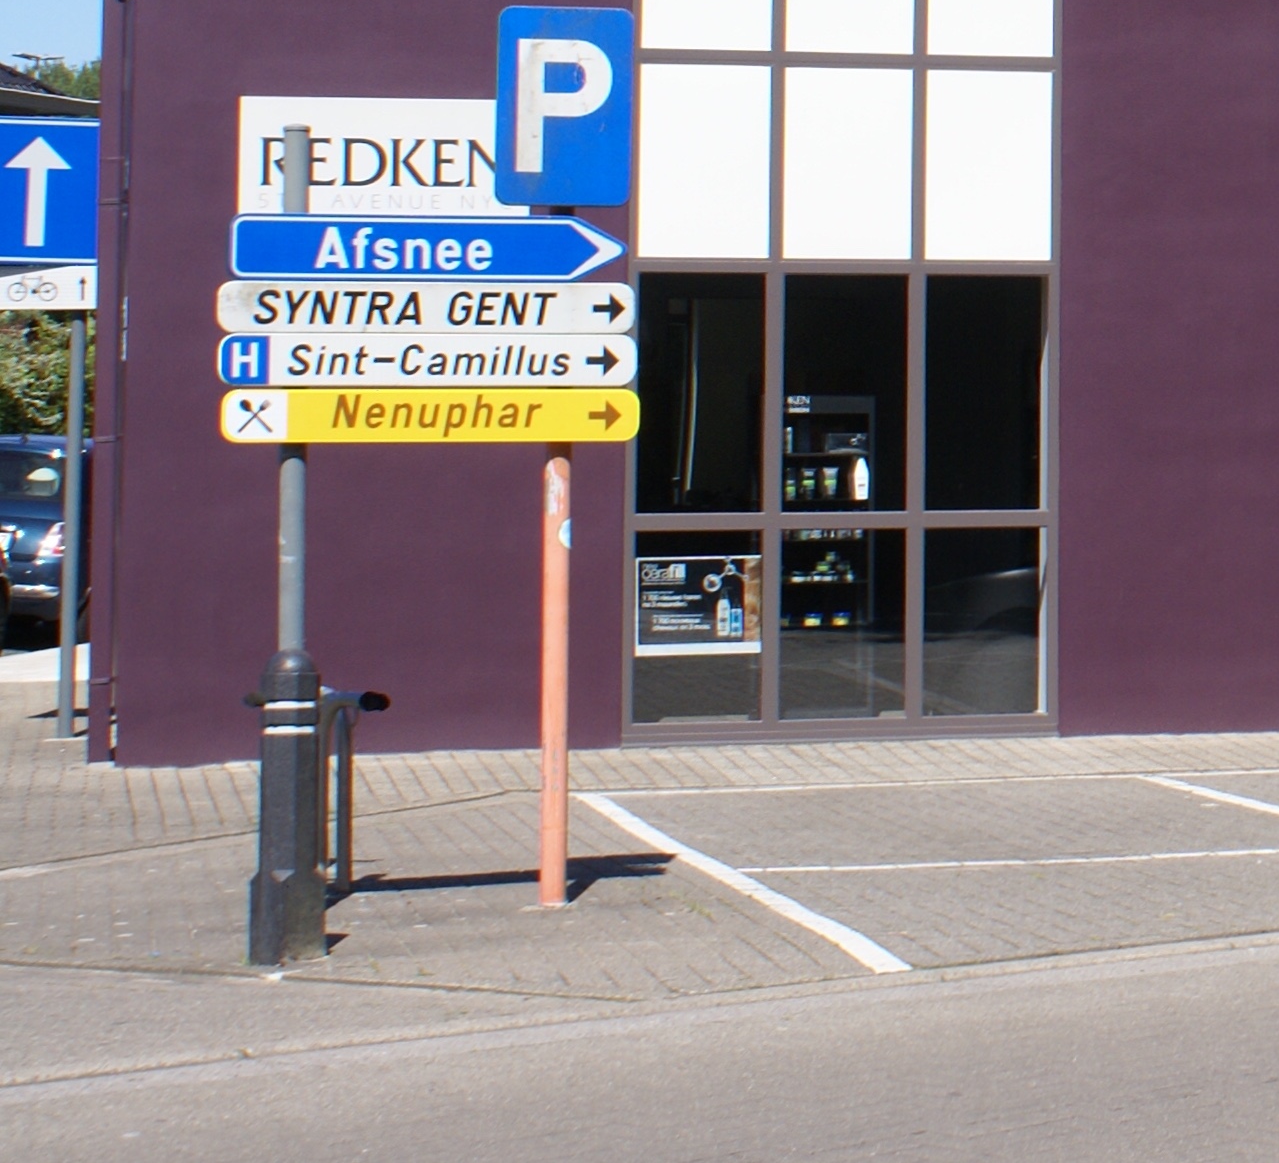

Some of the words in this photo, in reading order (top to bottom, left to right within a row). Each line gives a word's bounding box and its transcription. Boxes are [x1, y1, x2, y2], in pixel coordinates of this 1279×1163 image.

[514, 39, 612, 173] P
[331, 193, 441, 210] AVENUE
[461, 194, 512, 211] NY
[314, 226, 493, 270] Afsnee
[253, 289, 420, 325] SYNTRA
[447, 291, 557, 326] GENT
[230, 342, 259, 378] H
[287, 344, 570, 376] Sint-Camillus
[332, 394, 543, 436] Nenuphar
